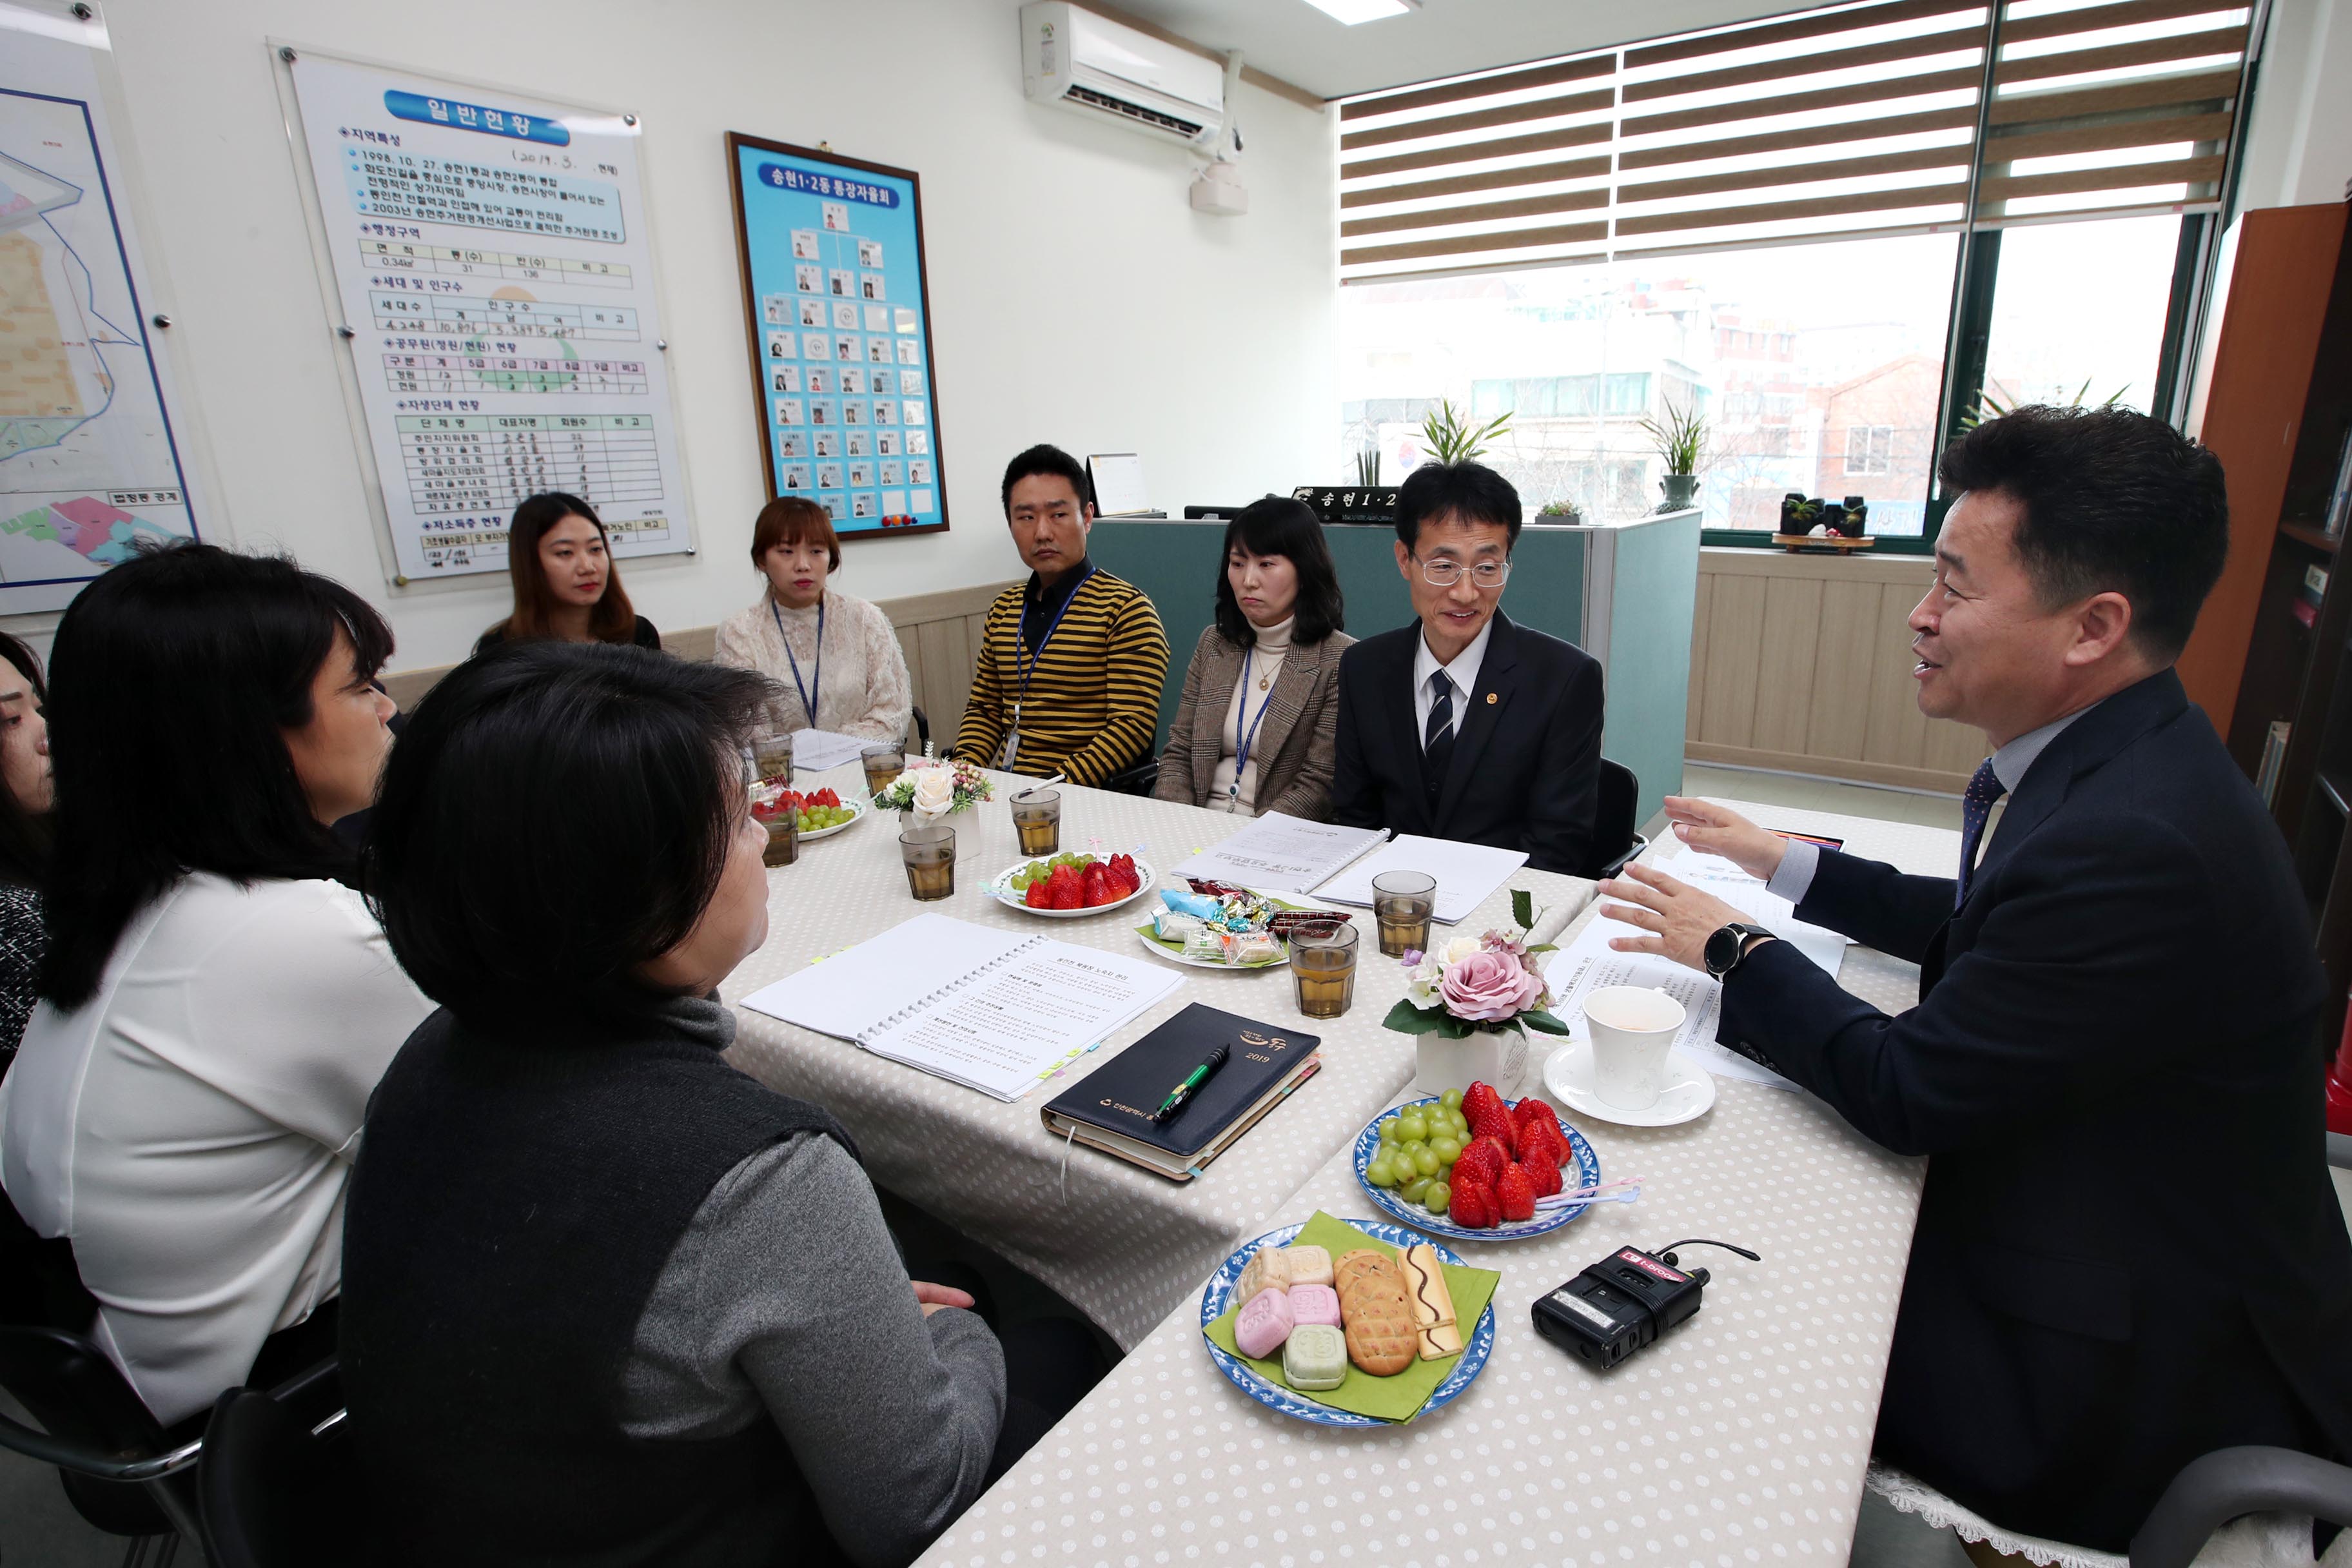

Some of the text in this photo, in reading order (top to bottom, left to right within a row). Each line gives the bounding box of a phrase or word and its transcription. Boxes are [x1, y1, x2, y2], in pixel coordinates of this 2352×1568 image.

[427, 98, 531, 137] 일반현황
[352, 128, 400, 147] 지역특성
[399, 155, 416, 167] 10.
[423, 160, 440, 170] 27.
[367, 176, 465, 198] 전형적인 상가지역임
[422, 172, 463, 186] 중심으로
[511, 185, 556, 199] 송현시장이
[588, 195, 605, 206] 있는
[772, 168, 890, 206] 송현1·2동 통장자율회
[369, 190, 563, 222] 동인천 전철역과 인접해 있어 교통이 편리함
[372, 203, 411, 217] 2003년
[536, 222, 562, 234] 쾌적한
[565, 226, 598, 238] 주거환경
[602, 230, 618, 240] 조성
[371, 223, 420, 239] 행정구역
[462, 264, 473, 273] 31
[384, 276, 463, 292] 세대 및 인구수
[496, 342, 516, 353] 현황
[502, 360, 517, 369] 6급
[534, 361, 548, 369] 7급
[565, 362, 580, 370] 8급
[594, 363, 609, 371] 9급
[622, 364, 638, 372] 비고
[397, 370, 415, 380] 정원
[408, 400, 480, 411] 자생단체 현황
[500, 418, 536, 427] 대표자명
[562, 418, 587, 426] 회원수
[433, 516, 502, 530] 저소득층 현황
[1245, 1052, 1270, 1063] 2019
